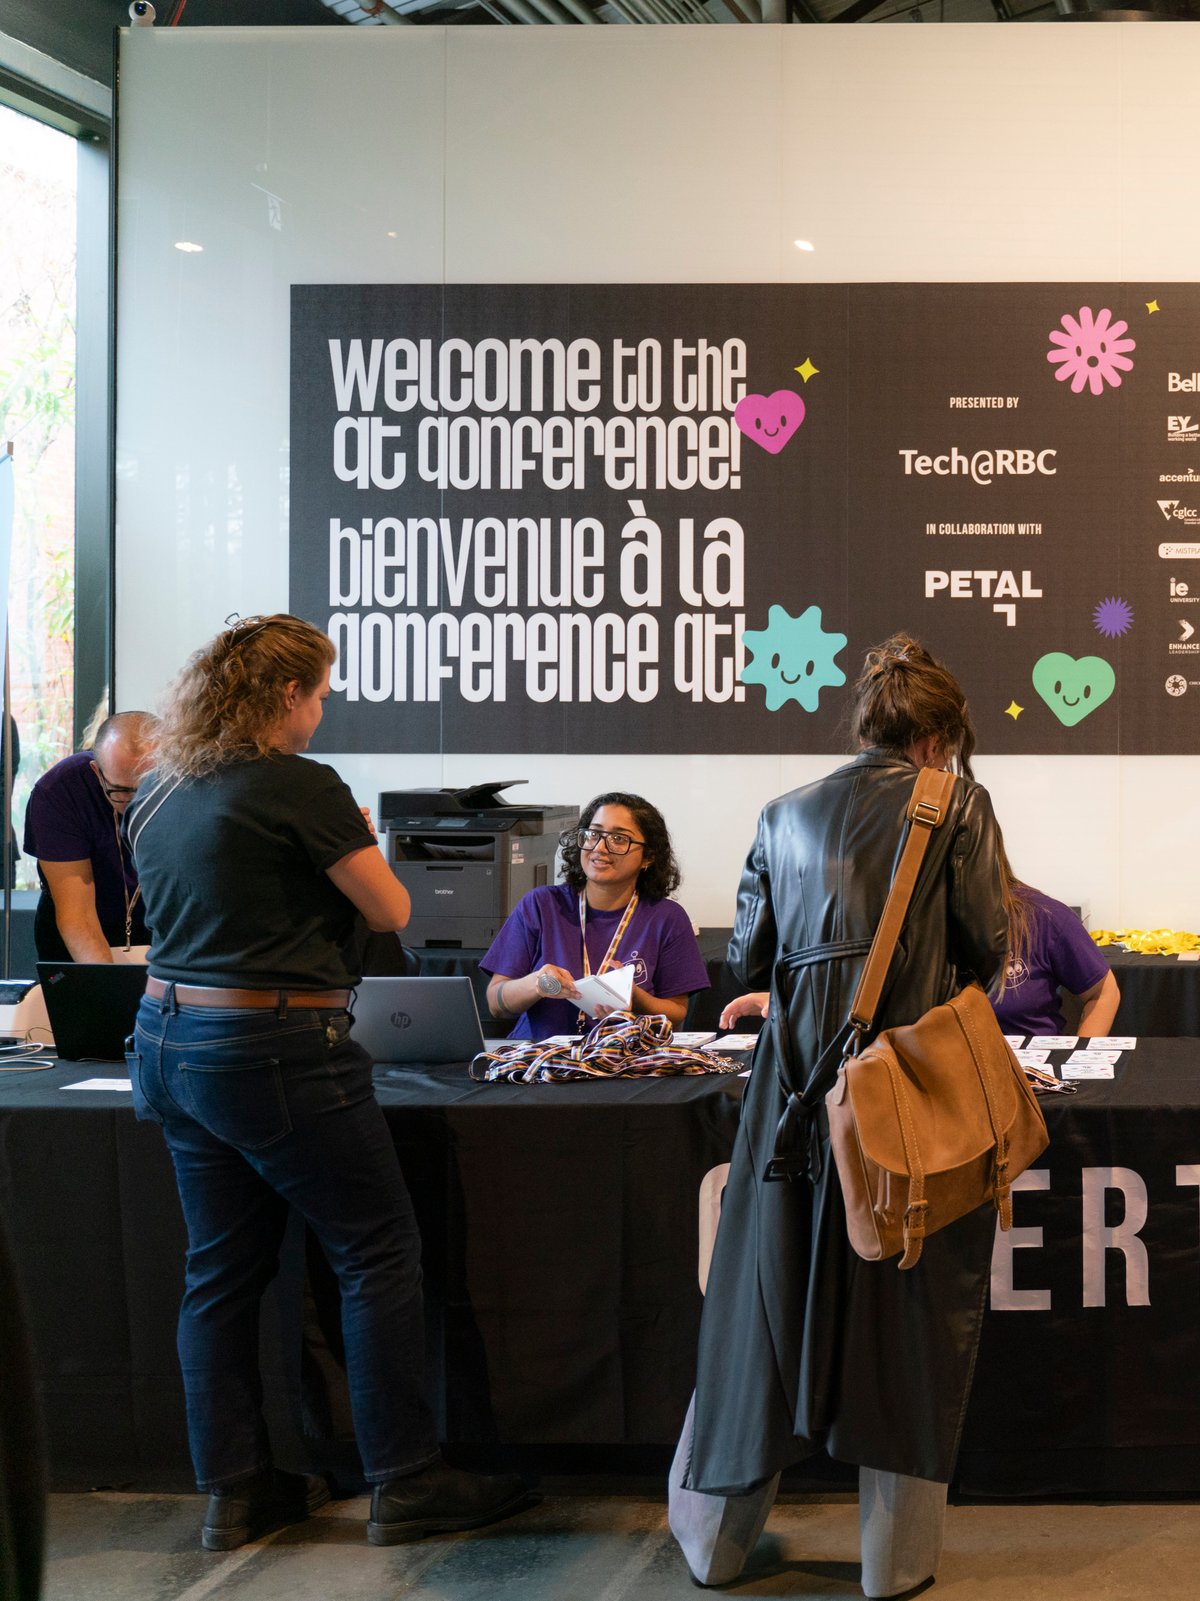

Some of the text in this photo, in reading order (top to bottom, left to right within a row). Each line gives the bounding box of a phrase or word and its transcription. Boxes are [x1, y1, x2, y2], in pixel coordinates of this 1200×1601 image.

[613, 338, 662, 412] to
[673, 338, 747, 412] the
[949, 397, 1019, 409] PRESENTED BY
[1167, 415, 1194, 432] EY
[899, 447, 1057, 485] Tech@RBC
[1172, 507, 1198, 520] cglcc
[926, 523, 1042, 535] IN COLLABORATION WITH
[925, 570, 1043, 598] PETAL
